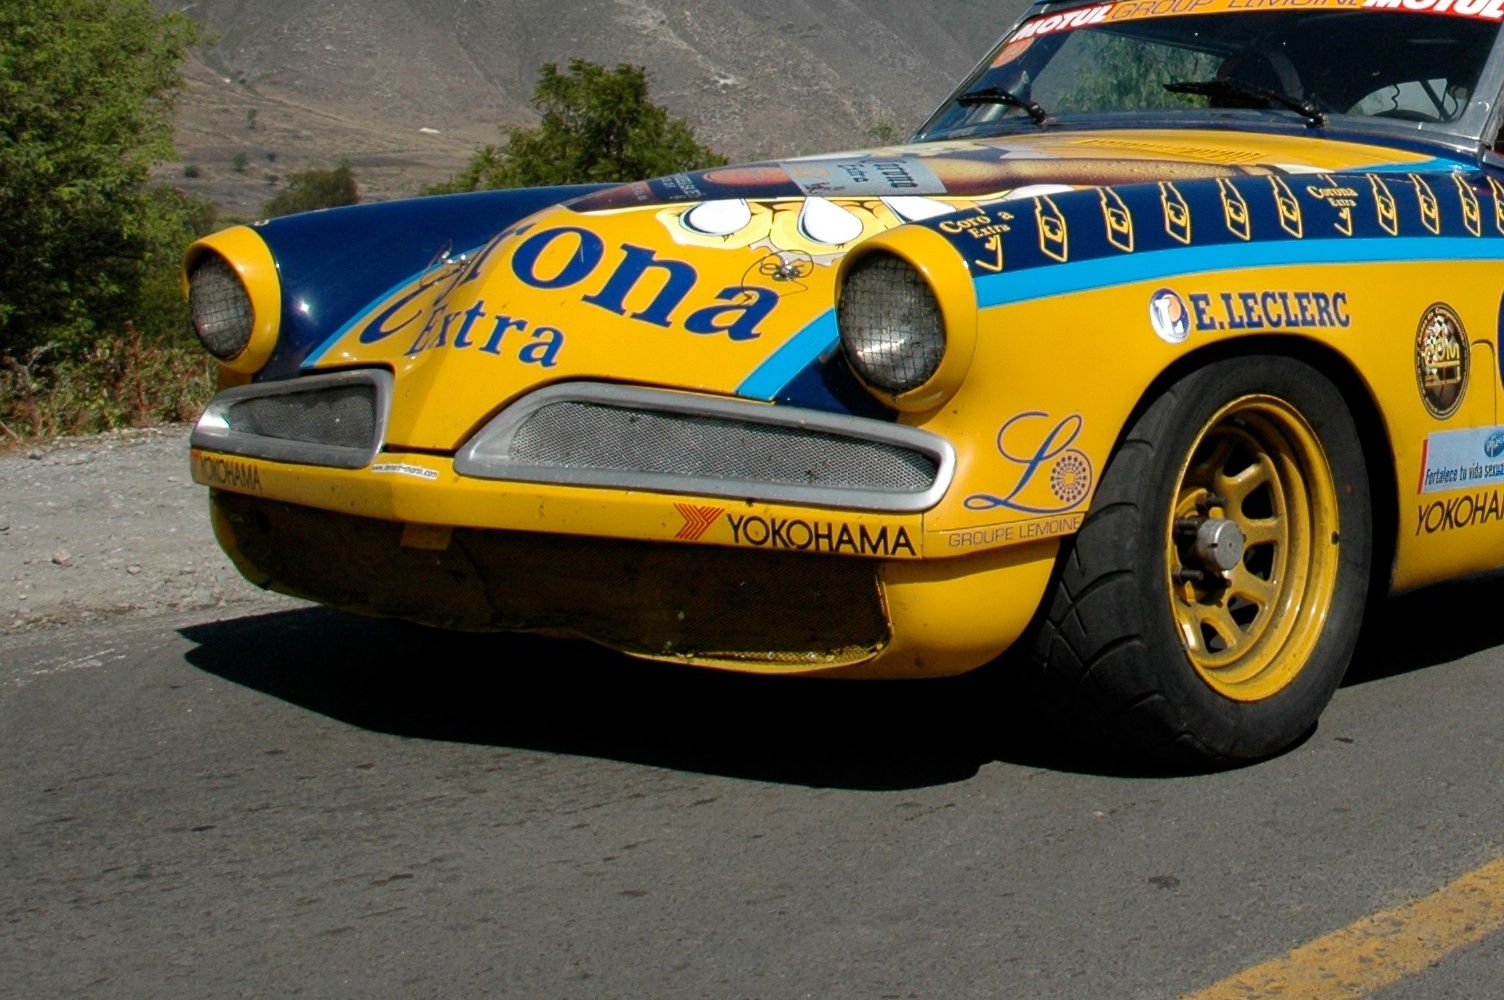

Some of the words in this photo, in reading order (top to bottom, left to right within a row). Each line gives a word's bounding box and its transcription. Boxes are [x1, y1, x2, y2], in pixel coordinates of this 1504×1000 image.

[1009, 4, 1114, 42] MOTUL
[939, 211, 1015, 233] Coroa
[967, 224, 1011, 239] Extra
[359, 222, 779, 344] Crona
[1189, 291, 1350, 331] E.LECLERC
[404, 299, 564, 368] Extra
[200, 456, 262, 491] YOKOHAMA
[1425, 467, 1458, 486] Fortalece
[1460, 465, 1467, 481] tu
[1469, 462, 1483, 480] vida
[727, 513, 917, 557] YOKOHAMA
[948, 526, 1014, 548] GROUPE
[1019, 516, 1081, 539] LEMOINE
